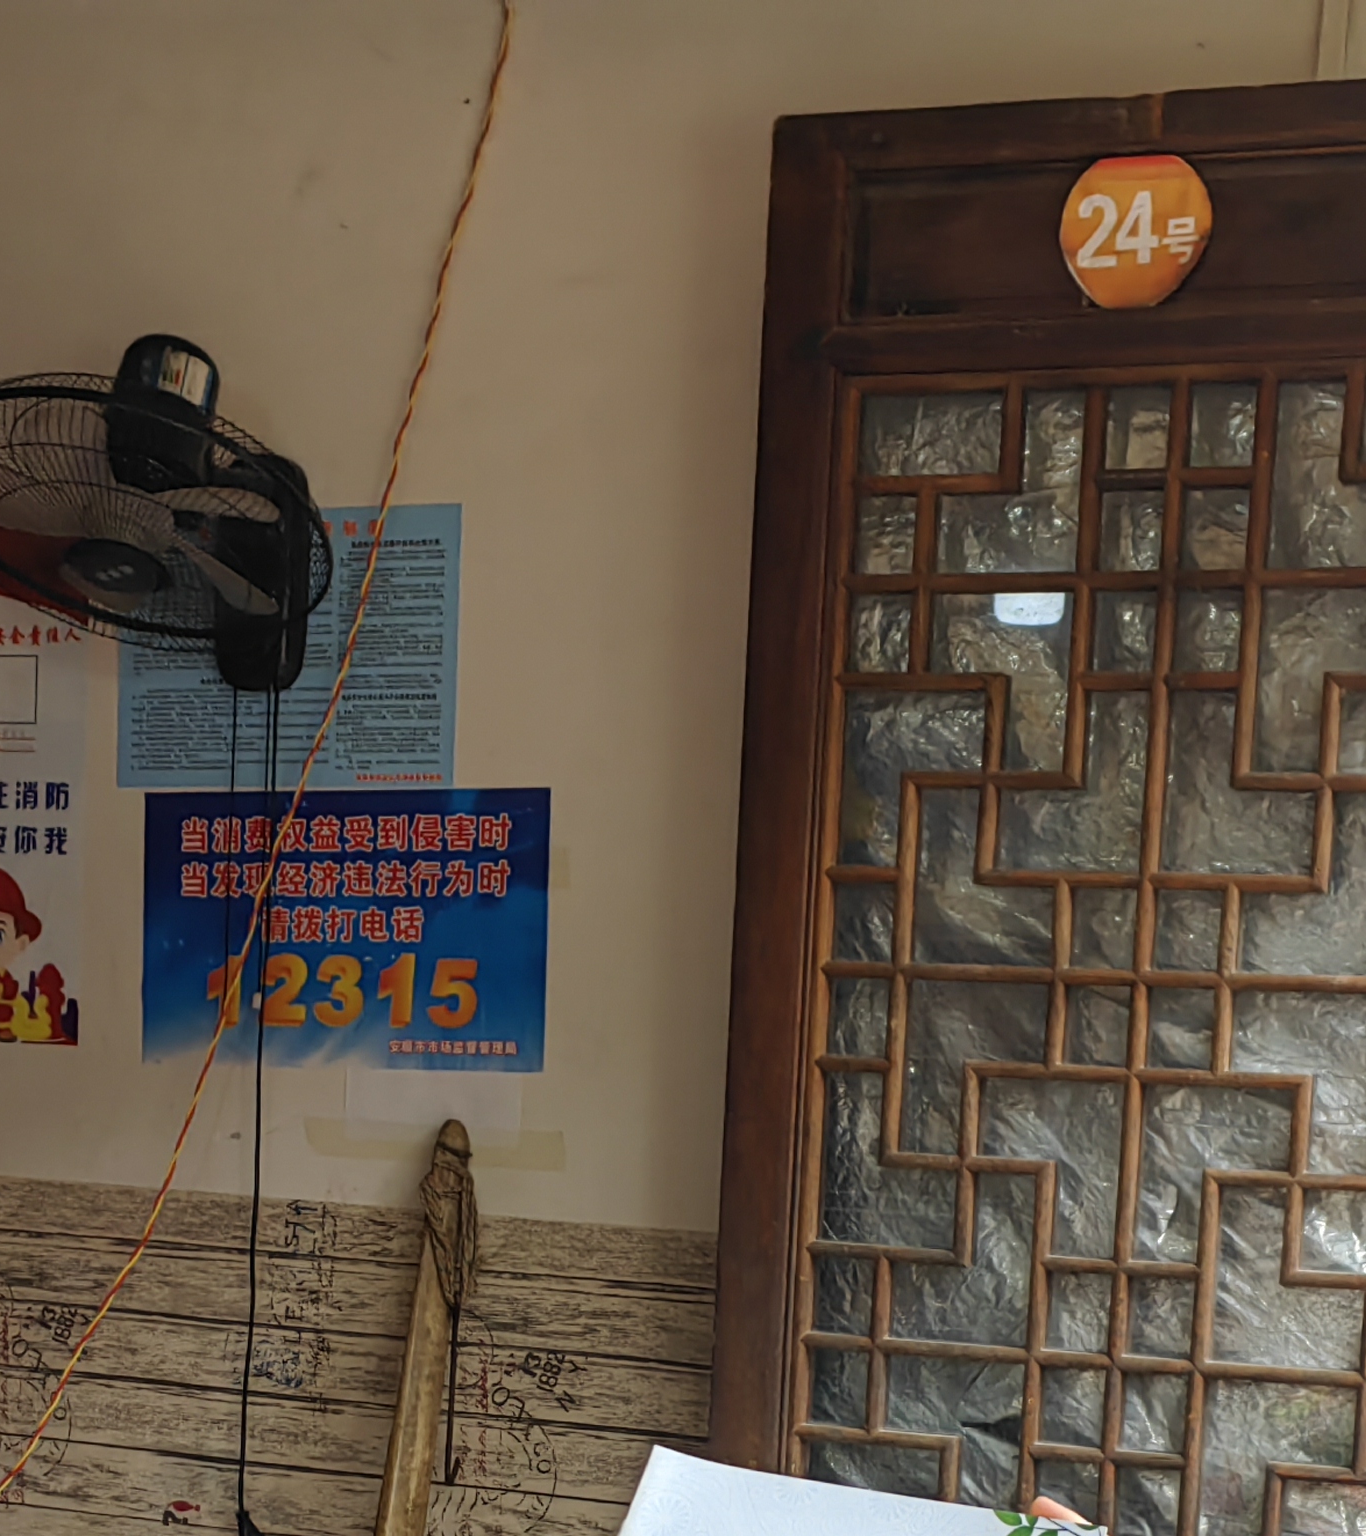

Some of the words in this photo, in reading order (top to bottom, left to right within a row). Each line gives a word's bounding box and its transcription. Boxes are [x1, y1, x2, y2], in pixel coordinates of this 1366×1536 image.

[1076, 190, 1202, 269] 24号
[180, 813, 512, 854] 当消费权益受到侵害时
[180, 860, 511, 898] 当发现经济违法行为时
[259, 906, 425, 943] 请拨打电话
[206, 952, 480, 1030] 12315
